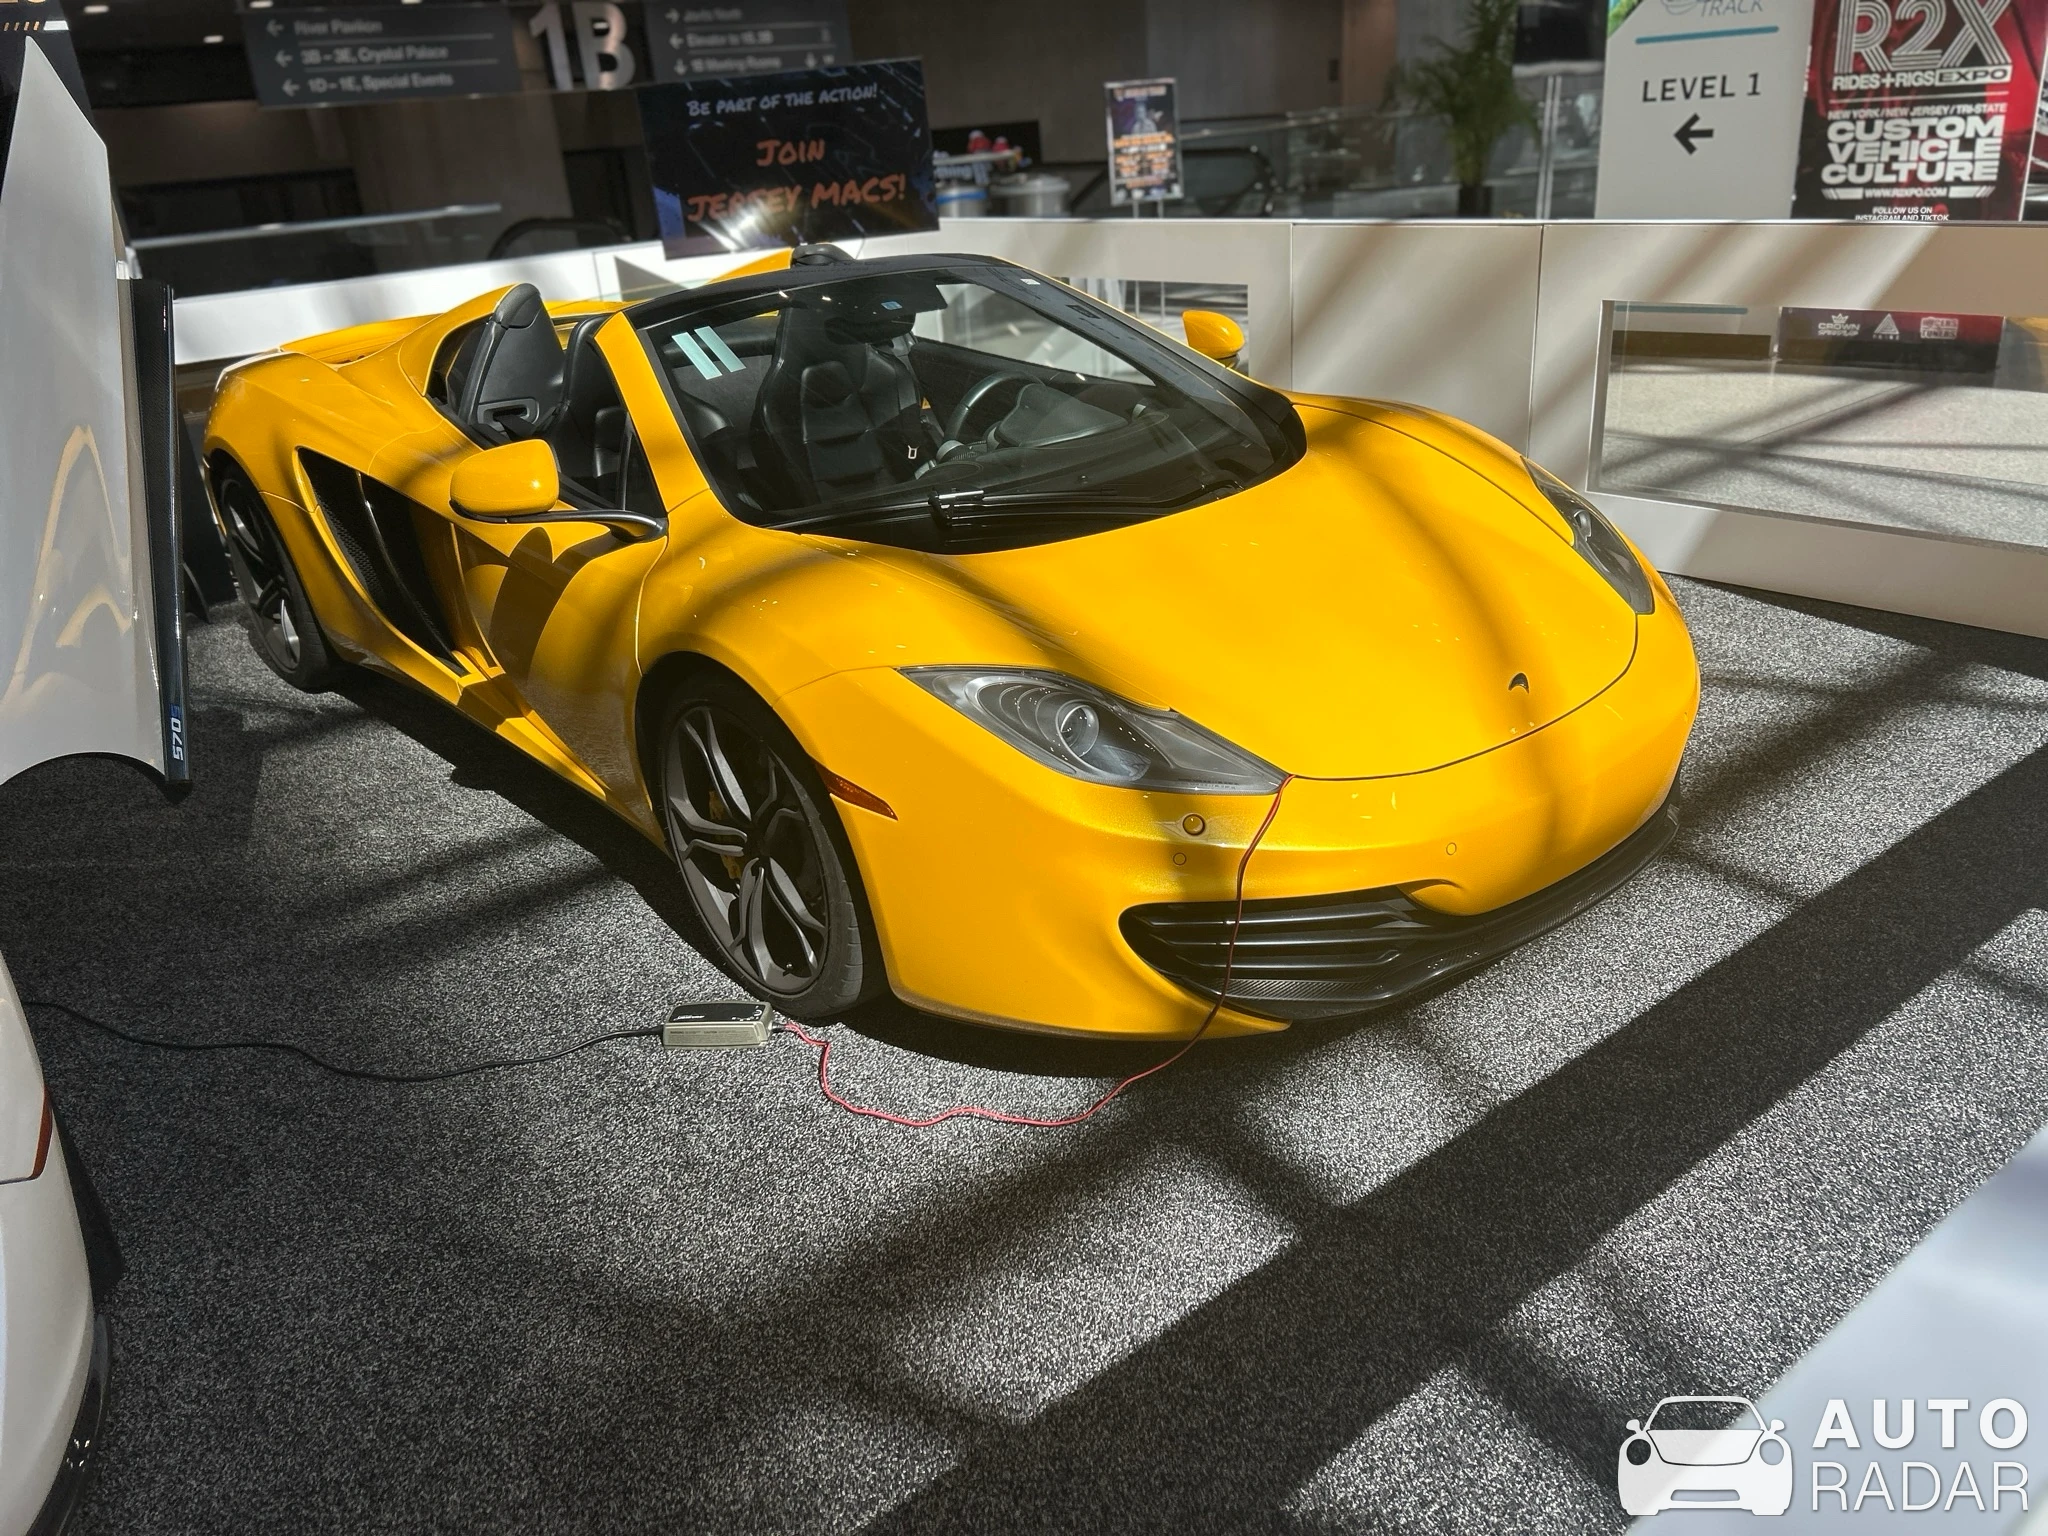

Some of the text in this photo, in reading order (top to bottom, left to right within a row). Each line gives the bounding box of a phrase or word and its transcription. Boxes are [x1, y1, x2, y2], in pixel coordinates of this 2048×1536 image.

[529, 0, 636, 91] 1B
[1834, 0, 2012, 74] R2X
[362, 74, 410, 92] Special
[411, 72, 455, 87] Events
[1642, 72, 1762, 103] LEVEL 1
[1832, 69, 2008, 91] RIDES+RIGS EXPO
[687, 82, 878, 117] BE PART OF THE ACTION!
[1910, 104, 1949, 116] JERSEY
[1827, 115, 2005, 143] CUSTOM
[756, 138, 825, 167] JOIN
[1827, 138, 2003, 163] VEHICLE
[1821, 161, 1999, 184] CULTURE
[811, 173, 906, 209] MACS!
[1872, 206, 1933, 214] FOLLOW US ON
[1818, 322, 1861, 332] CROWN
[170, 703, 184, 761] 570S
